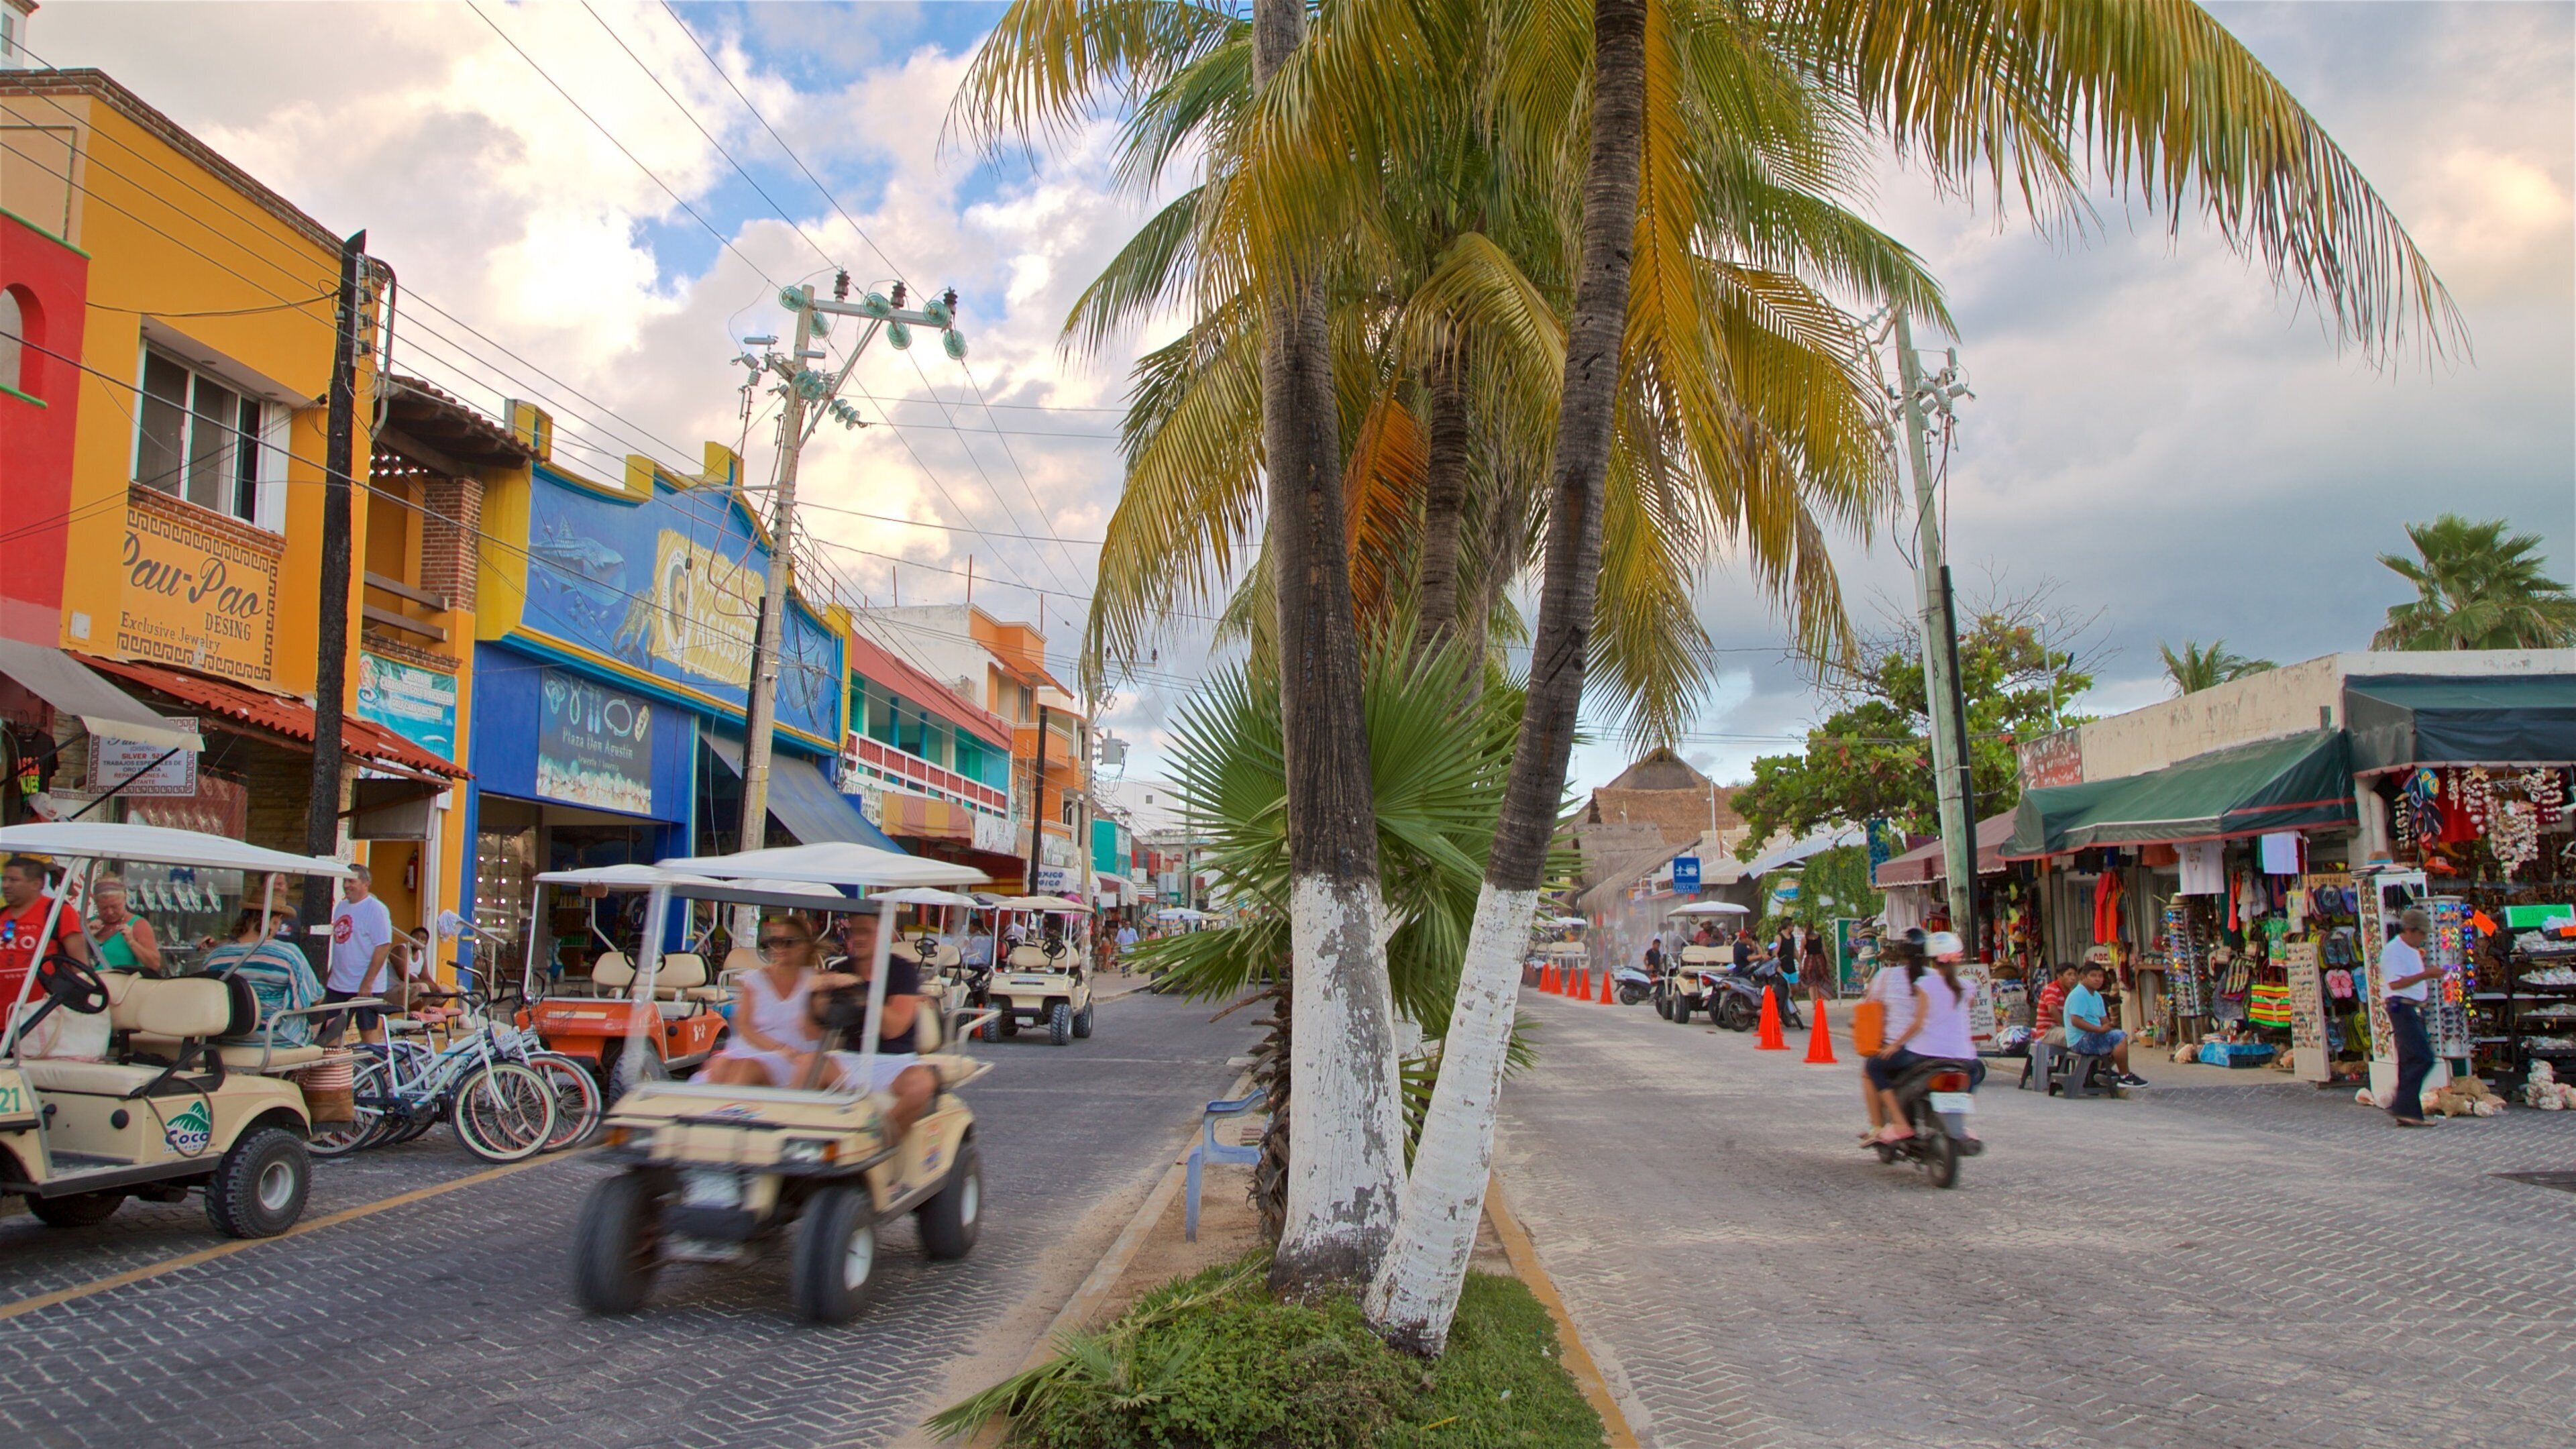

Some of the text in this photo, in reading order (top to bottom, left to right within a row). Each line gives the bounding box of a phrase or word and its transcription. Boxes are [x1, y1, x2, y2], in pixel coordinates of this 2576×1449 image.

[121, 610, 221, 654] Exclusive Jewelry
[205, 612, 252, 641] DESING
[563, 727, 584, 748] Plaza
[587, 733, 602, 753] Don
